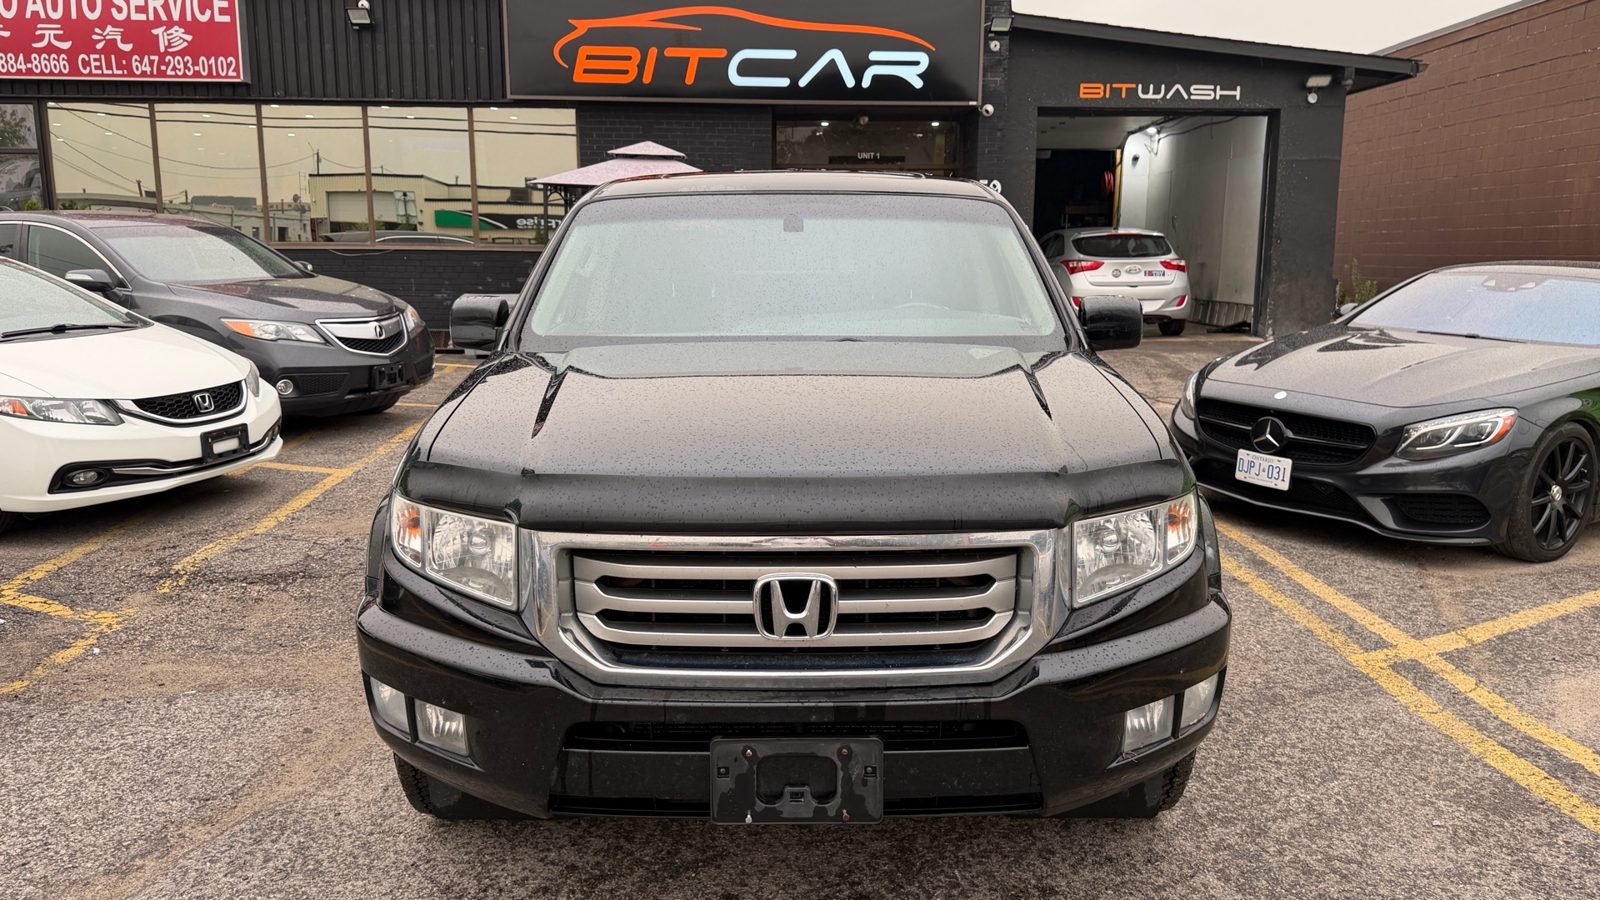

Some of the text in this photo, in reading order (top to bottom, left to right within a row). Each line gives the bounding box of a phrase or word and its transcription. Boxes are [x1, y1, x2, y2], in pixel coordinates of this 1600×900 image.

[25, 0, 101, 20] AUTO
[110, 0, 231, 22] SERVICE
[0, 24, 193, 53] 元汽修
[0, 53, 237, 77] 884-8666 CELL: 647-293-0102
[1079, 82, 1241, 101] BITWASH
[857, 152, 875, 160] UNIT
